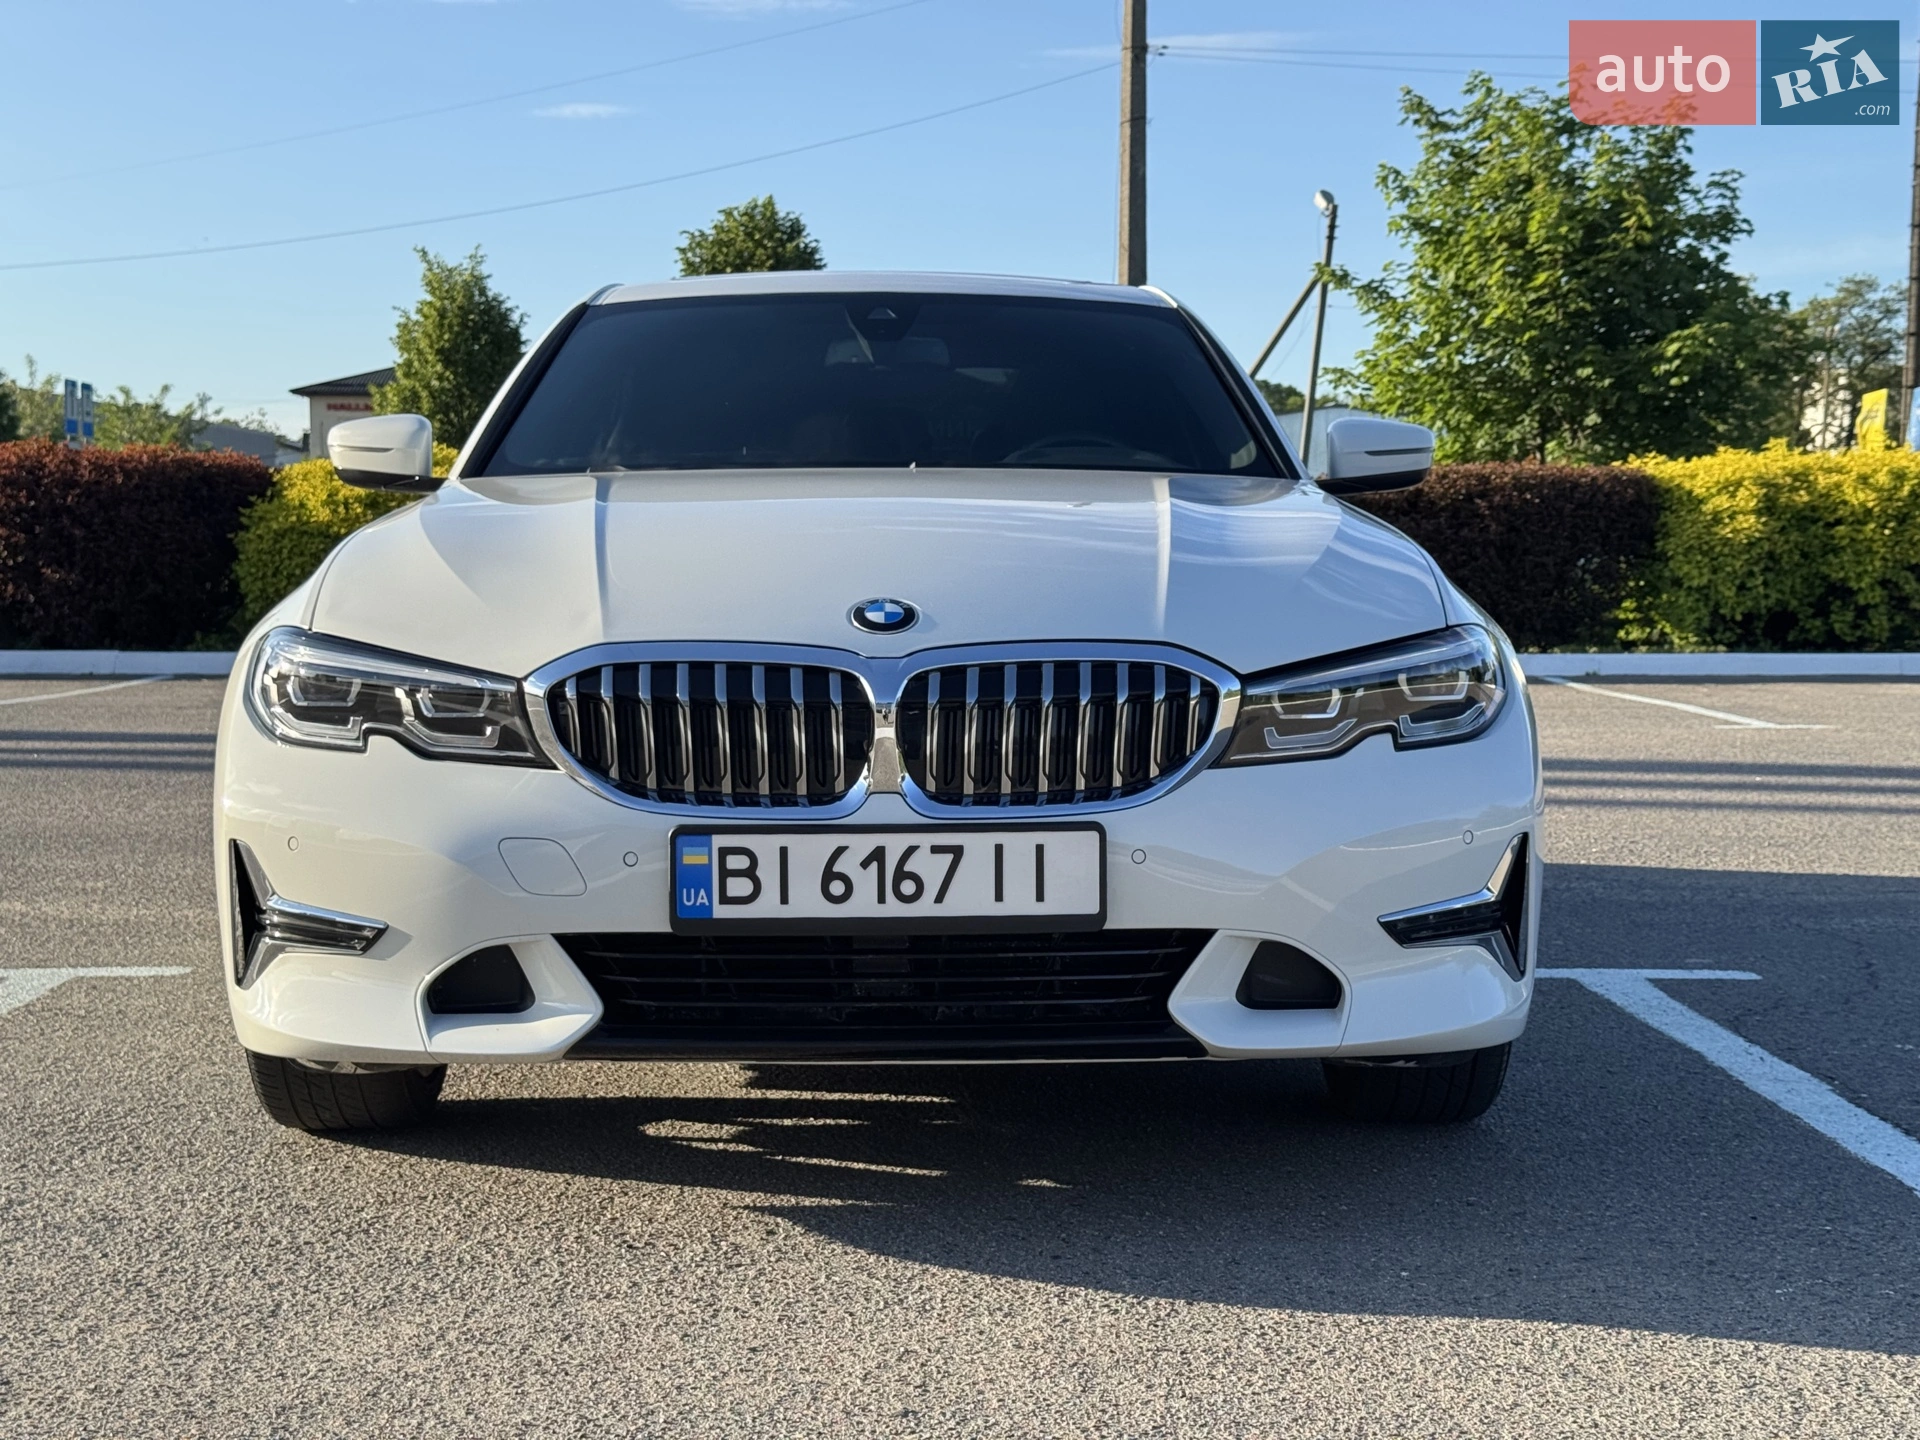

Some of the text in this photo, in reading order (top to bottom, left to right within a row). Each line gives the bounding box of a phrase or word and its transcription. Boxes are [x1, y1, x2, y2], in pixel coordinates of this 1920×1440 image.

[717, 843, 1045, 906] BI 6167 II
[682, 888, 709, 906] UA
